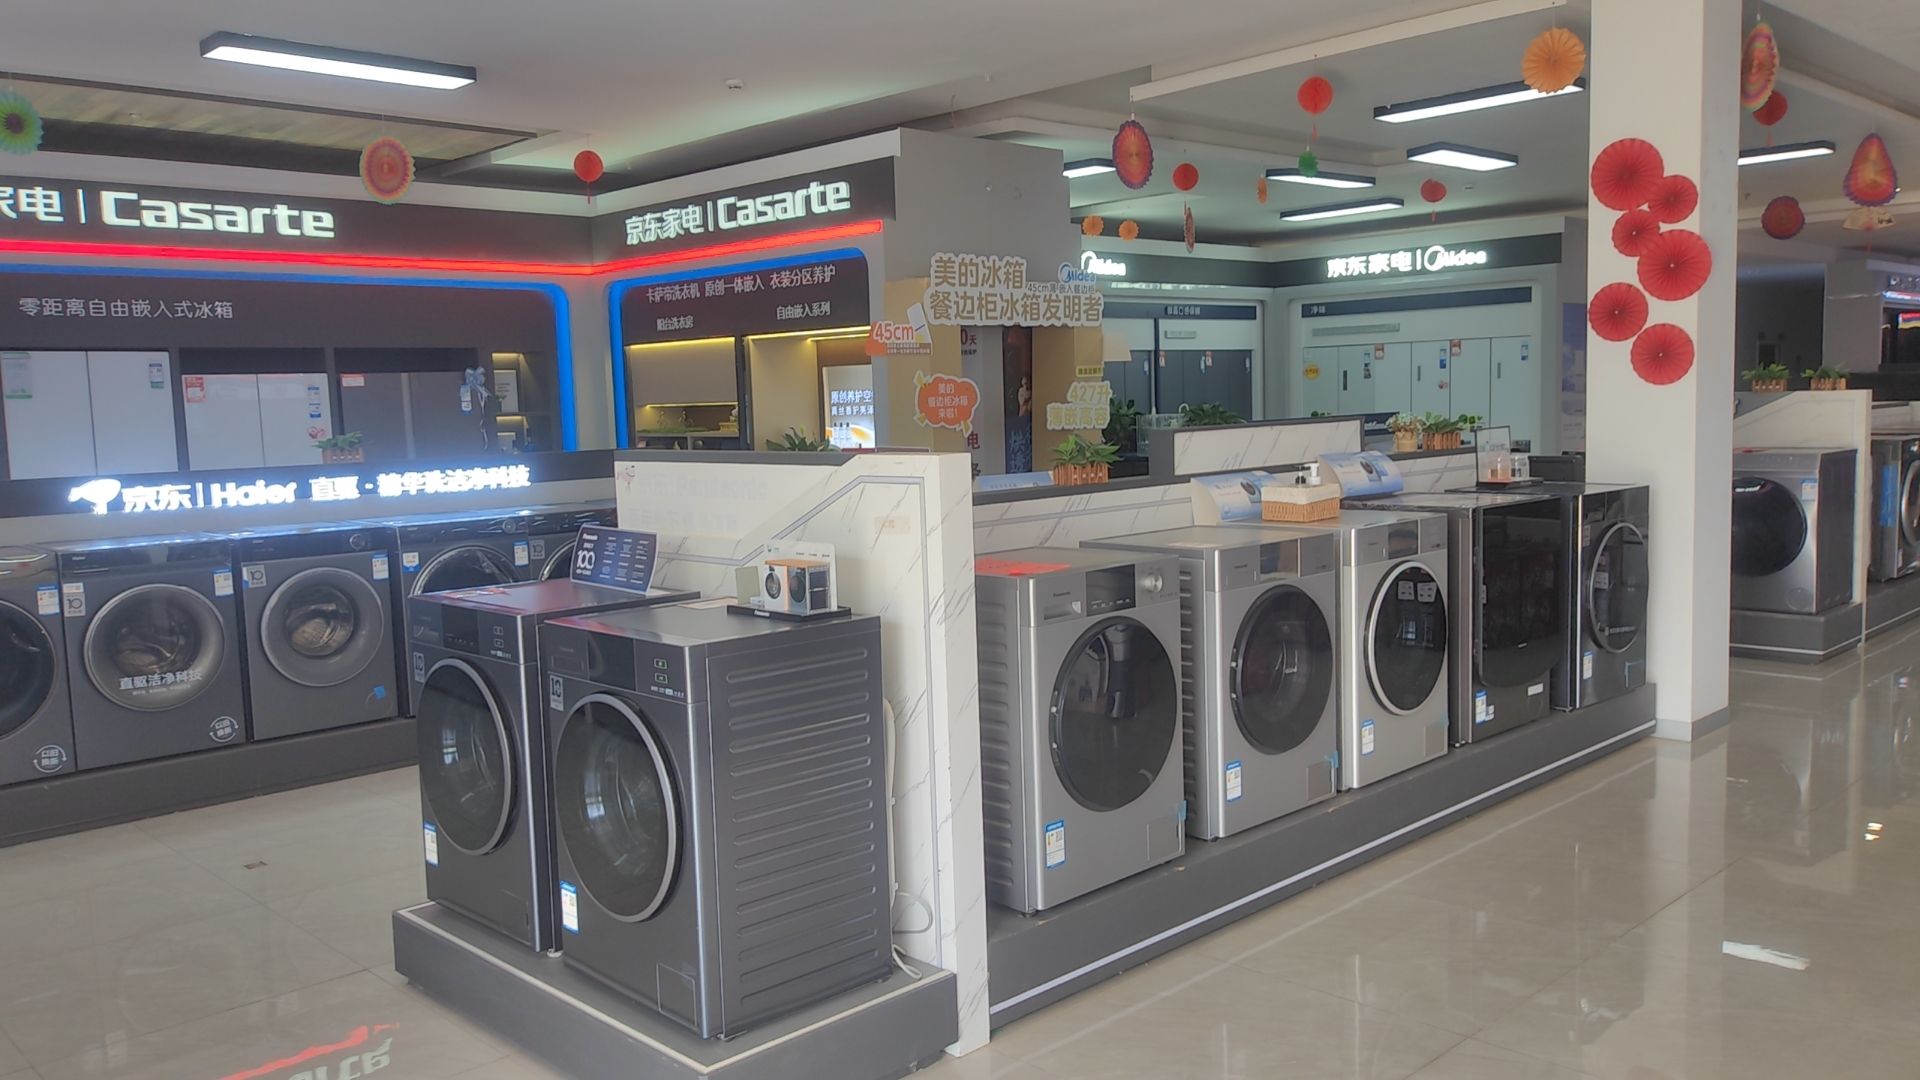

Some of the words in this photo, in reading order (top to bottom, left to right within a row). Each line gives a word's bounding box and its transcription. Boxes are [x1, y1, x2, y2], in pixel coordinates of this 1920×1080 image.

[100, 190, 335, 238] Casarte
[625, 204, 704, 245] 京东家电
[717, 181, 850, 230] Casarte
[1327, 250, 1412, 278] 京东家电
[1424, 245, 1487, 272] Midea
[934, 256, 1025, 289] 美的冰箱
[1060, 263, 1095, 283] Midea
[646, 282, 700, 303] 卡萨帝洗衣机
[705, 275, 765, 297] 原创一体嵌入
[770, 264, 836, 290] 衣装分区养护
[19, 297, 233, 319] 零距离自由嵌入式冰箱
[777, 301, 831, 320] 自由嵌入系列
[930, 290, 1102, 322] 餐边柜冰箱发明者
[656, 315, 694, 332] 阳台洗衣房
[873, 322, 914, 342] 45cm
[831, 390, 874, 404] 原创养护空
[938, 383, 955, 394] 美的
[928, 395, 968, 407] 餐边柜冰箱
[121, 484, 192, 513] 京东
[210, 479, 297, 508] Haier
[577, 549, 596, 570] 100
